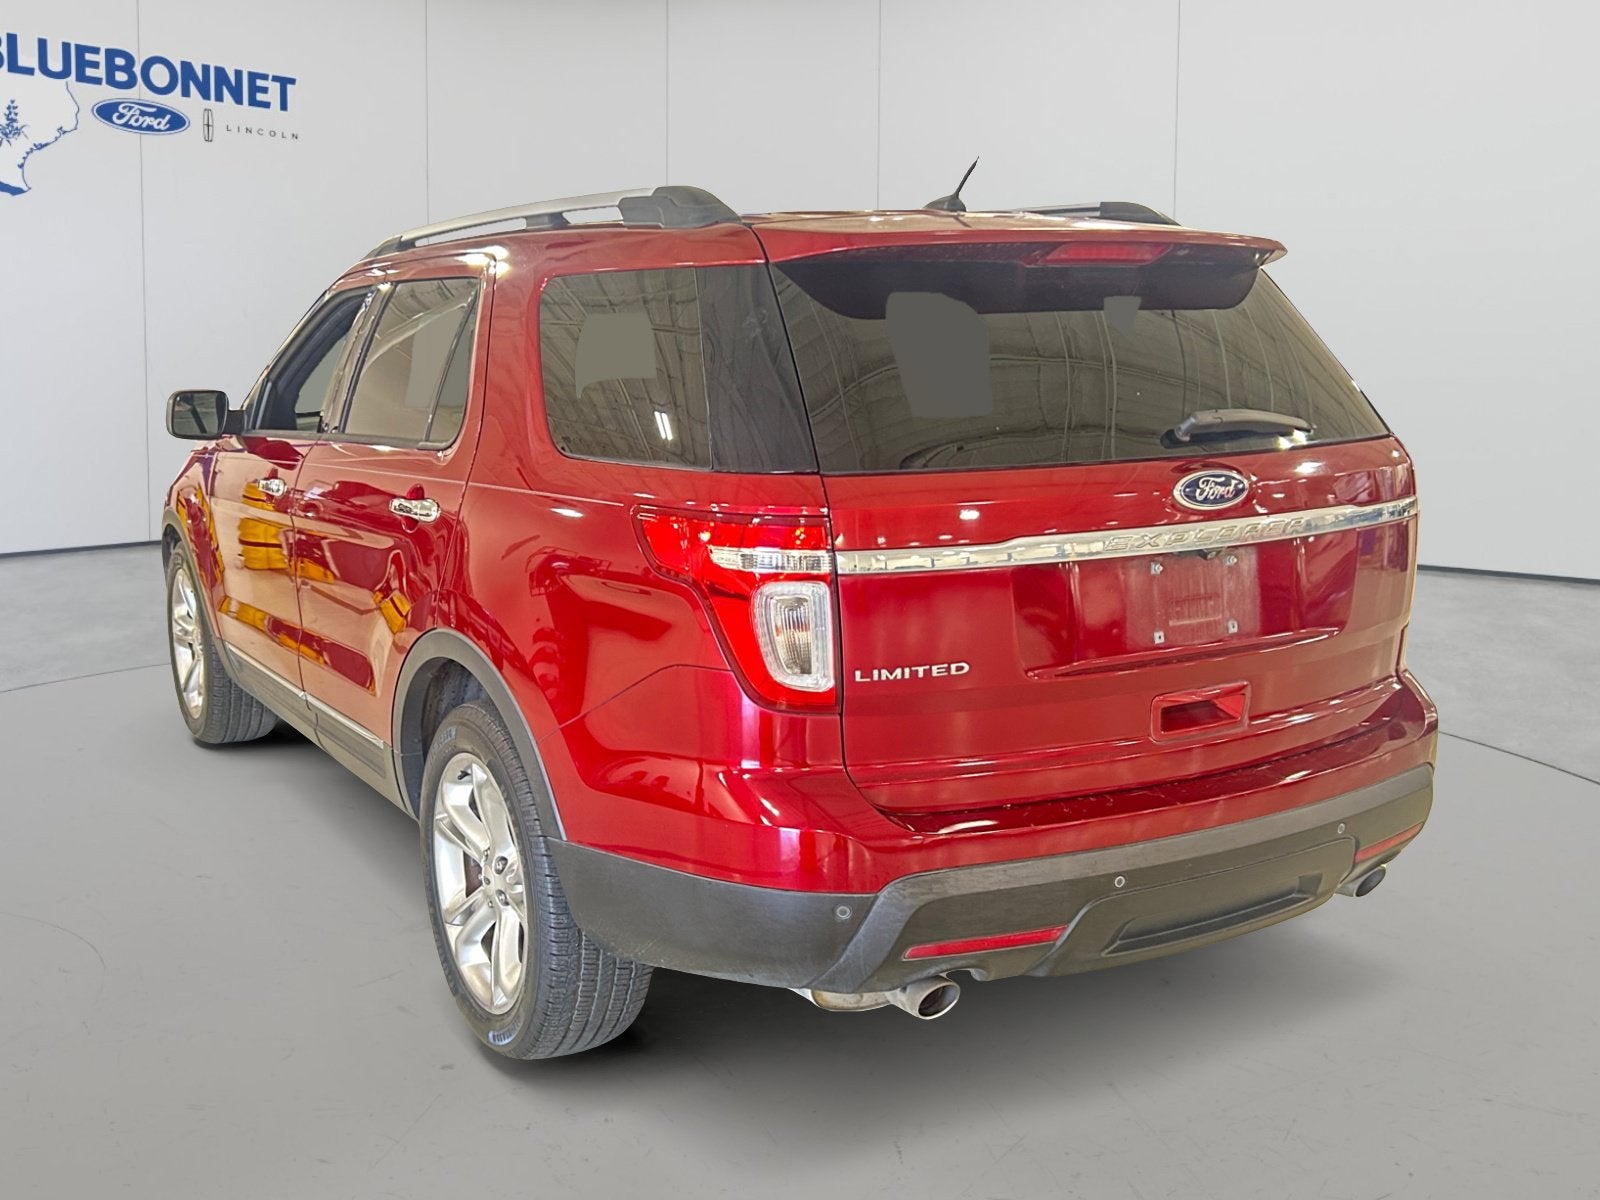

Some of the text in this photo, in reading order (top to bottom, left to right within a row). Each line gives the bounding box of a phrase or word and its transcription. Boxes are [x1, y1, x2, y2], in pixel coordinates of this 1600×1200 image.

[0, 32, 297, 112] LUEBONNET
[112, 102, 171, 131] Ford
[226, 124, 299, 140] LINCOLN
[1195, 476, 1239, 501] Ford
[1103, 517, 1305, 551] EXPLORER
[855, 662, 970, 682] LIMITED
